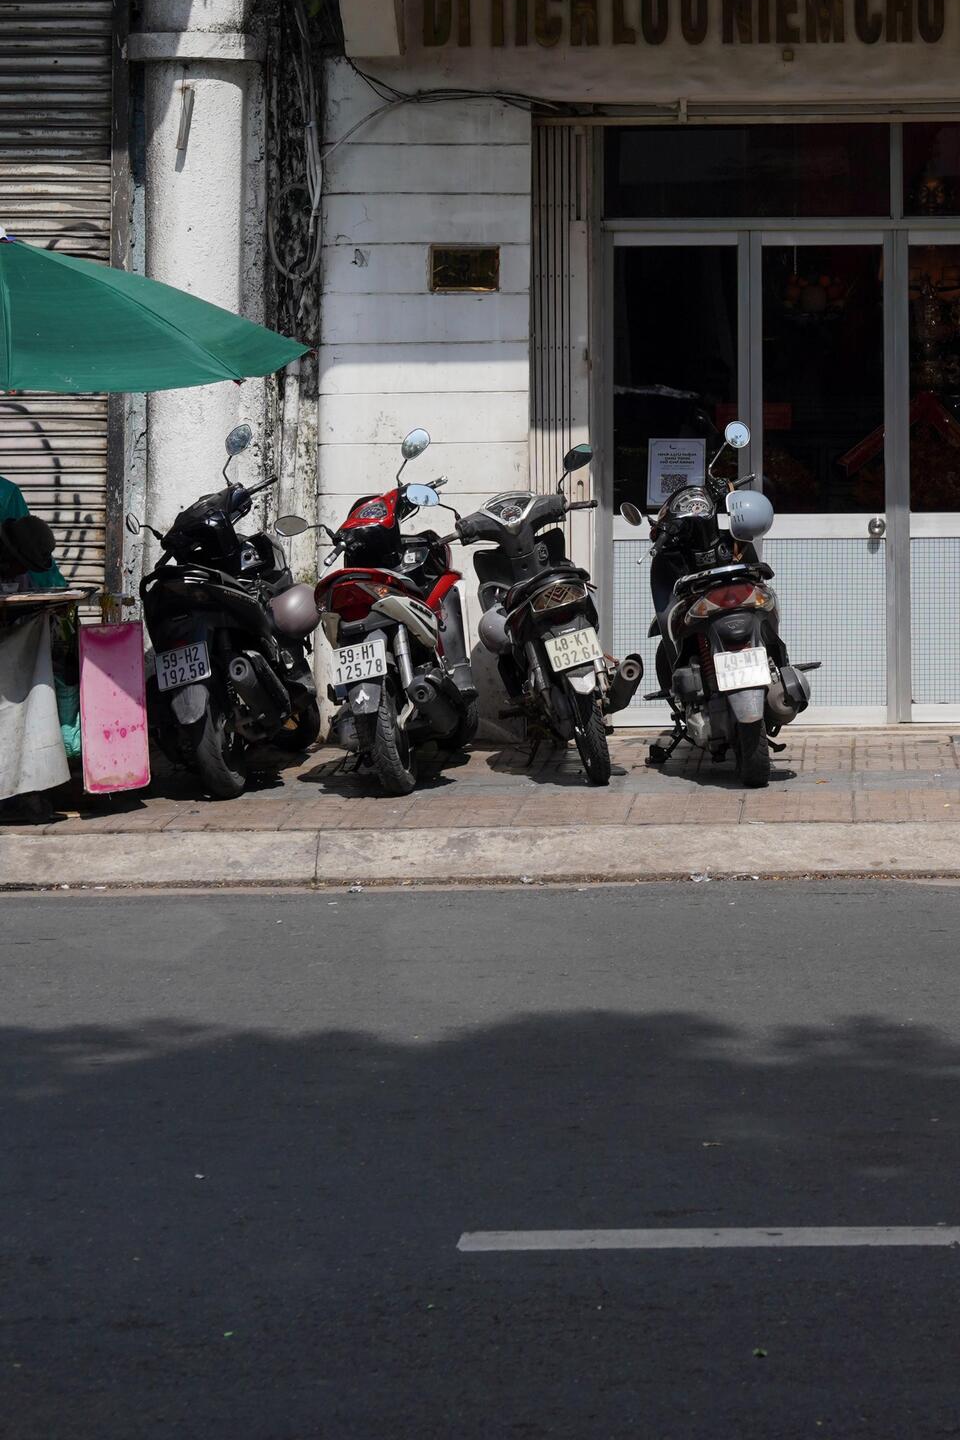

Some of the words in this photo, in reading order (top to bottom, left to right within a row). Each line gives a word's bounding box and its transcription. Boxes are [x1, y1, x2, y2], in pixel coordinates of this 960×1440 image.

[554, 631, 589, 652] 48-K1
[162, 646, 200, 669] 59-H2
[339, 644, 375, 665] 59-H1
[553, 643, 600, 669] 032.64
[162, 661, 206, 687] 192.58
[336, 658, 383, 682] 125.78
